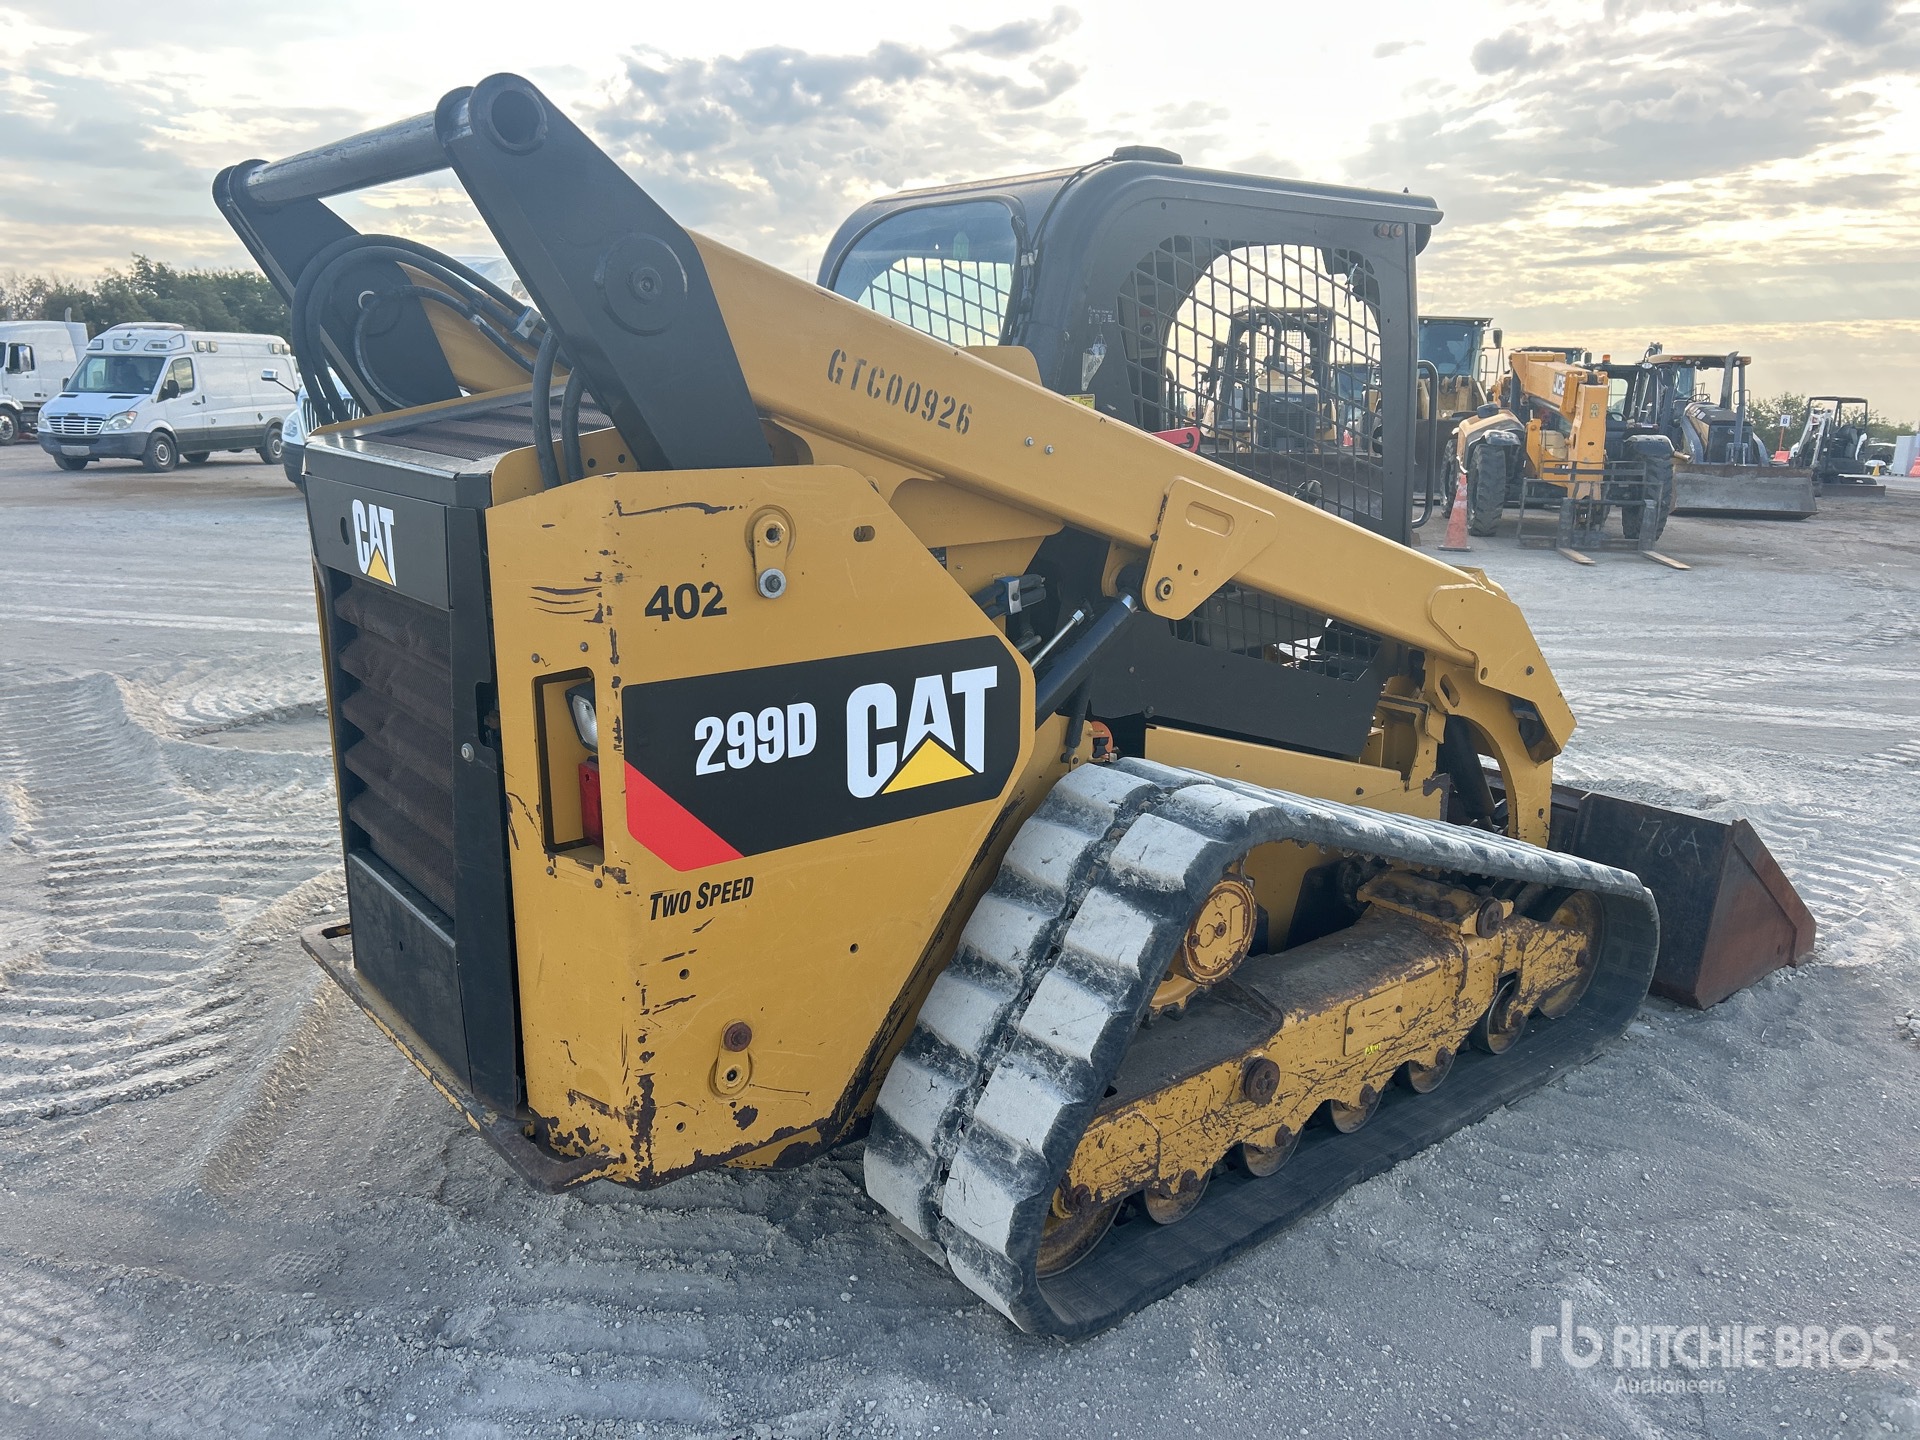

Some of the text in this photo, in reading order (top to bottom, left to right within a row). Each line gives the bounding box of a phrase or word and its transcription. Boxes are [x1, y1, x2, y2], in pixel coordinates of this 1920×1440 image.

[827, 348, 973, 435] GTC00926
[351, 498, 397, 587] CAT
[644, 581, 727, 622] 402
[694, 665, 998, 799] 299D CAT
[650, 876, 755, 921] TWO SPEED
